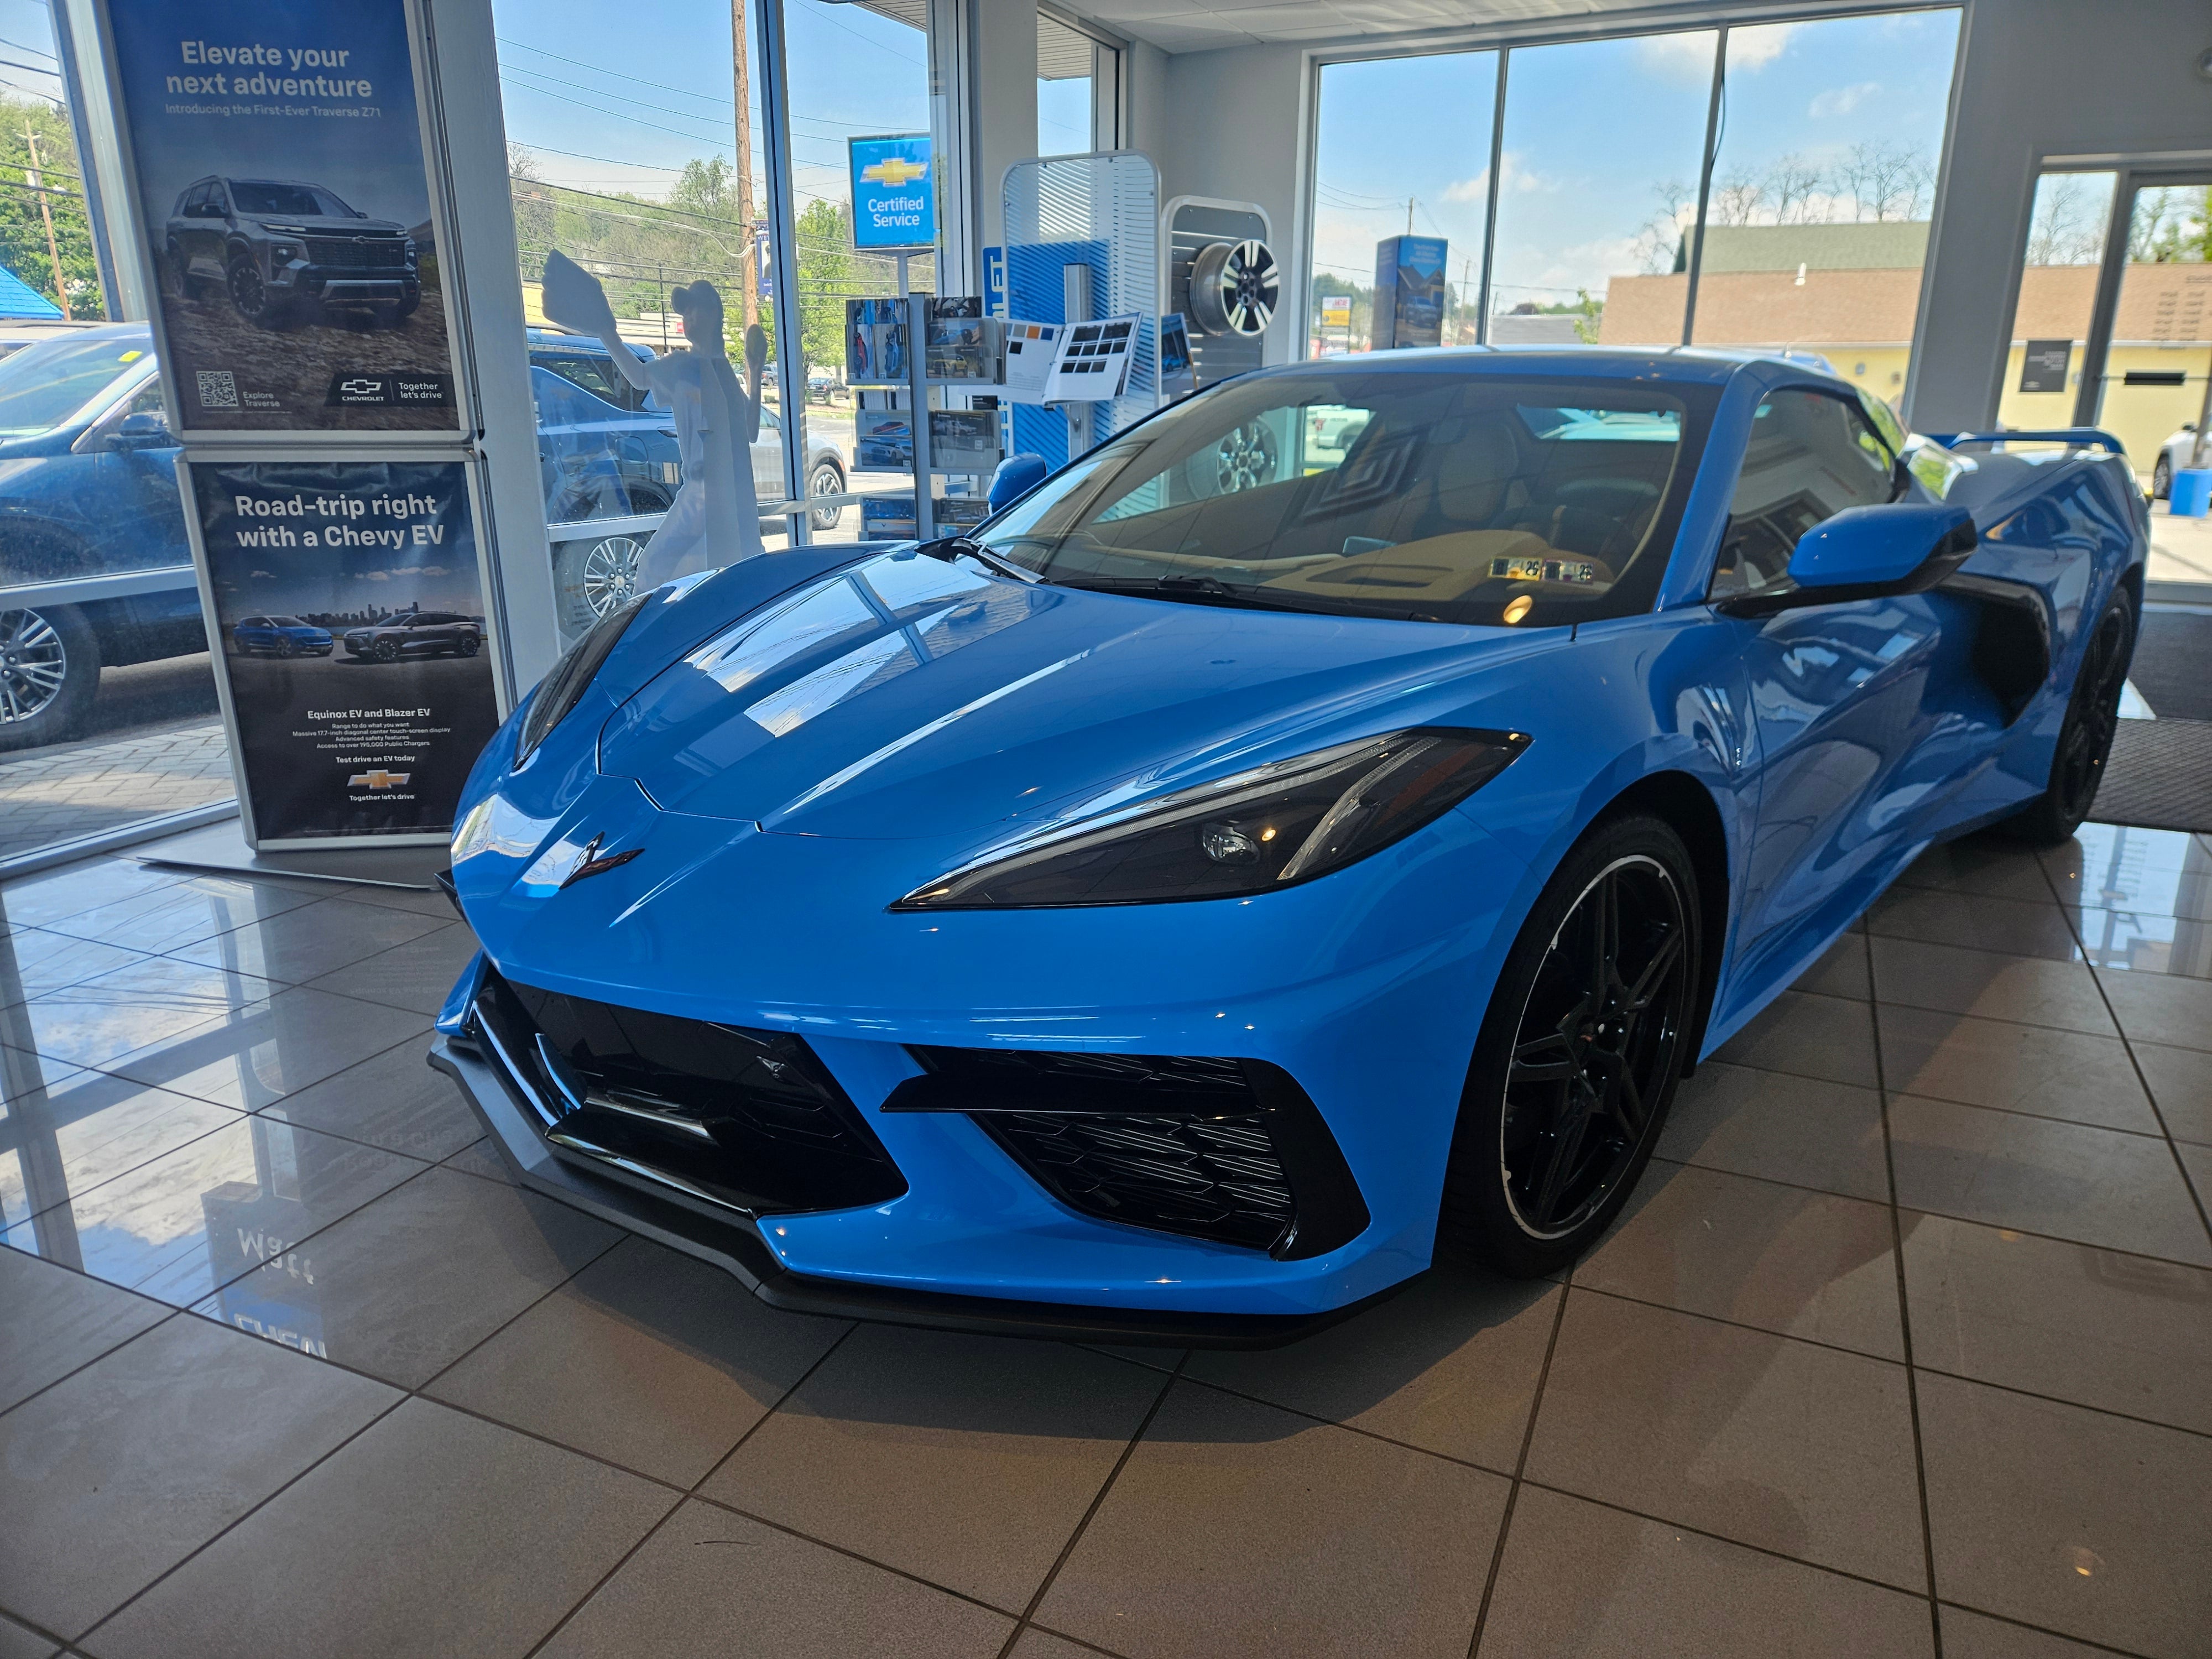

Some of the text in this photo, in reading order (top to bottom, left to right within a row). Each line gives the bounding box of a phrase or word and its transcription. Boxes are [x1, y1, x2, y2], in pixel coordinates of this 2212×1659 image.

[181, 40, 349, 71] Elevate your
[166, 71, 372, 97] next adventure
[165, 103, 381, 117] Introducing the First-Ever Traverse Z71
[868, 195, 924, 212] Certified
[873, 212, 920, 227] Service
[242, 391, 274, 399] Explore
[398, 382, 438, 392] Together
[235, 493, 437, 520] Road-trip right
[236, 524, 444, 550] with a Chevy EV
[307, 708, 430, 720] Equinox EV and Blazer EV
